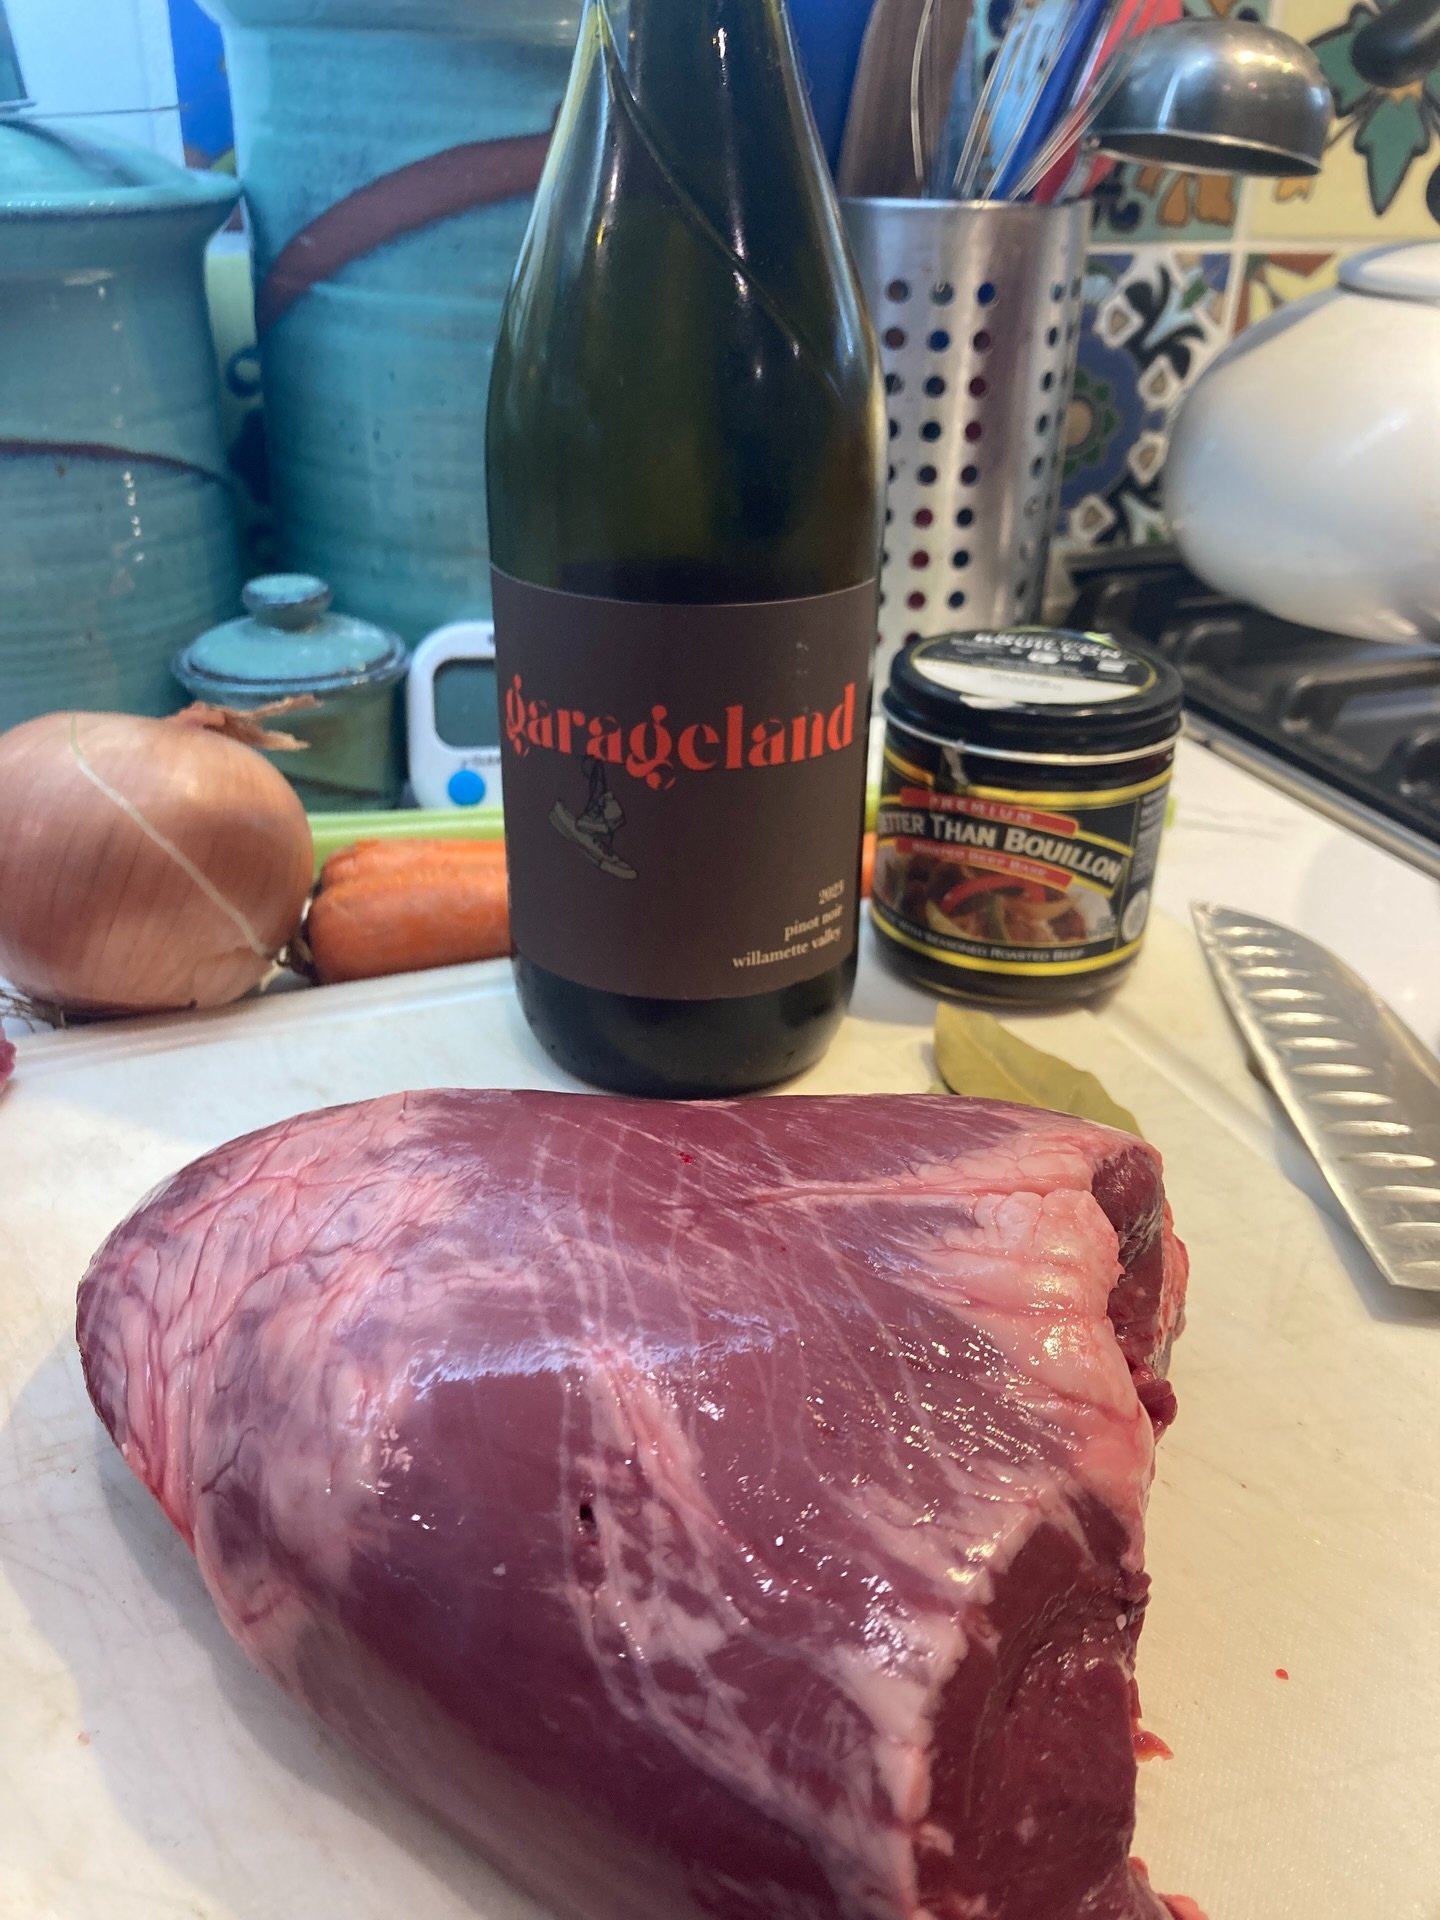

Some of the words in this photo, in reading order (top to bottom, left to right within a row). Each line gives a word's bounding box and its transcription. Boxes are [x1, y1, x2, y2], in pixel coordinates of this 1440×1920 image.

[506, 673, 855, 790] garageland
[930, 813, 997, 849] THAN
[1003, 827, 1122, 884] BOUILLON
[784, 916, 820, 942] pinot
[822, 903, 843, 925] noir
[732, 942, 809, 968] willamette
[811, 926, 843, 949] valley
[990, 946, 1050, 961] ROASTED
[1052, 948, 1085, 962] BEEF
